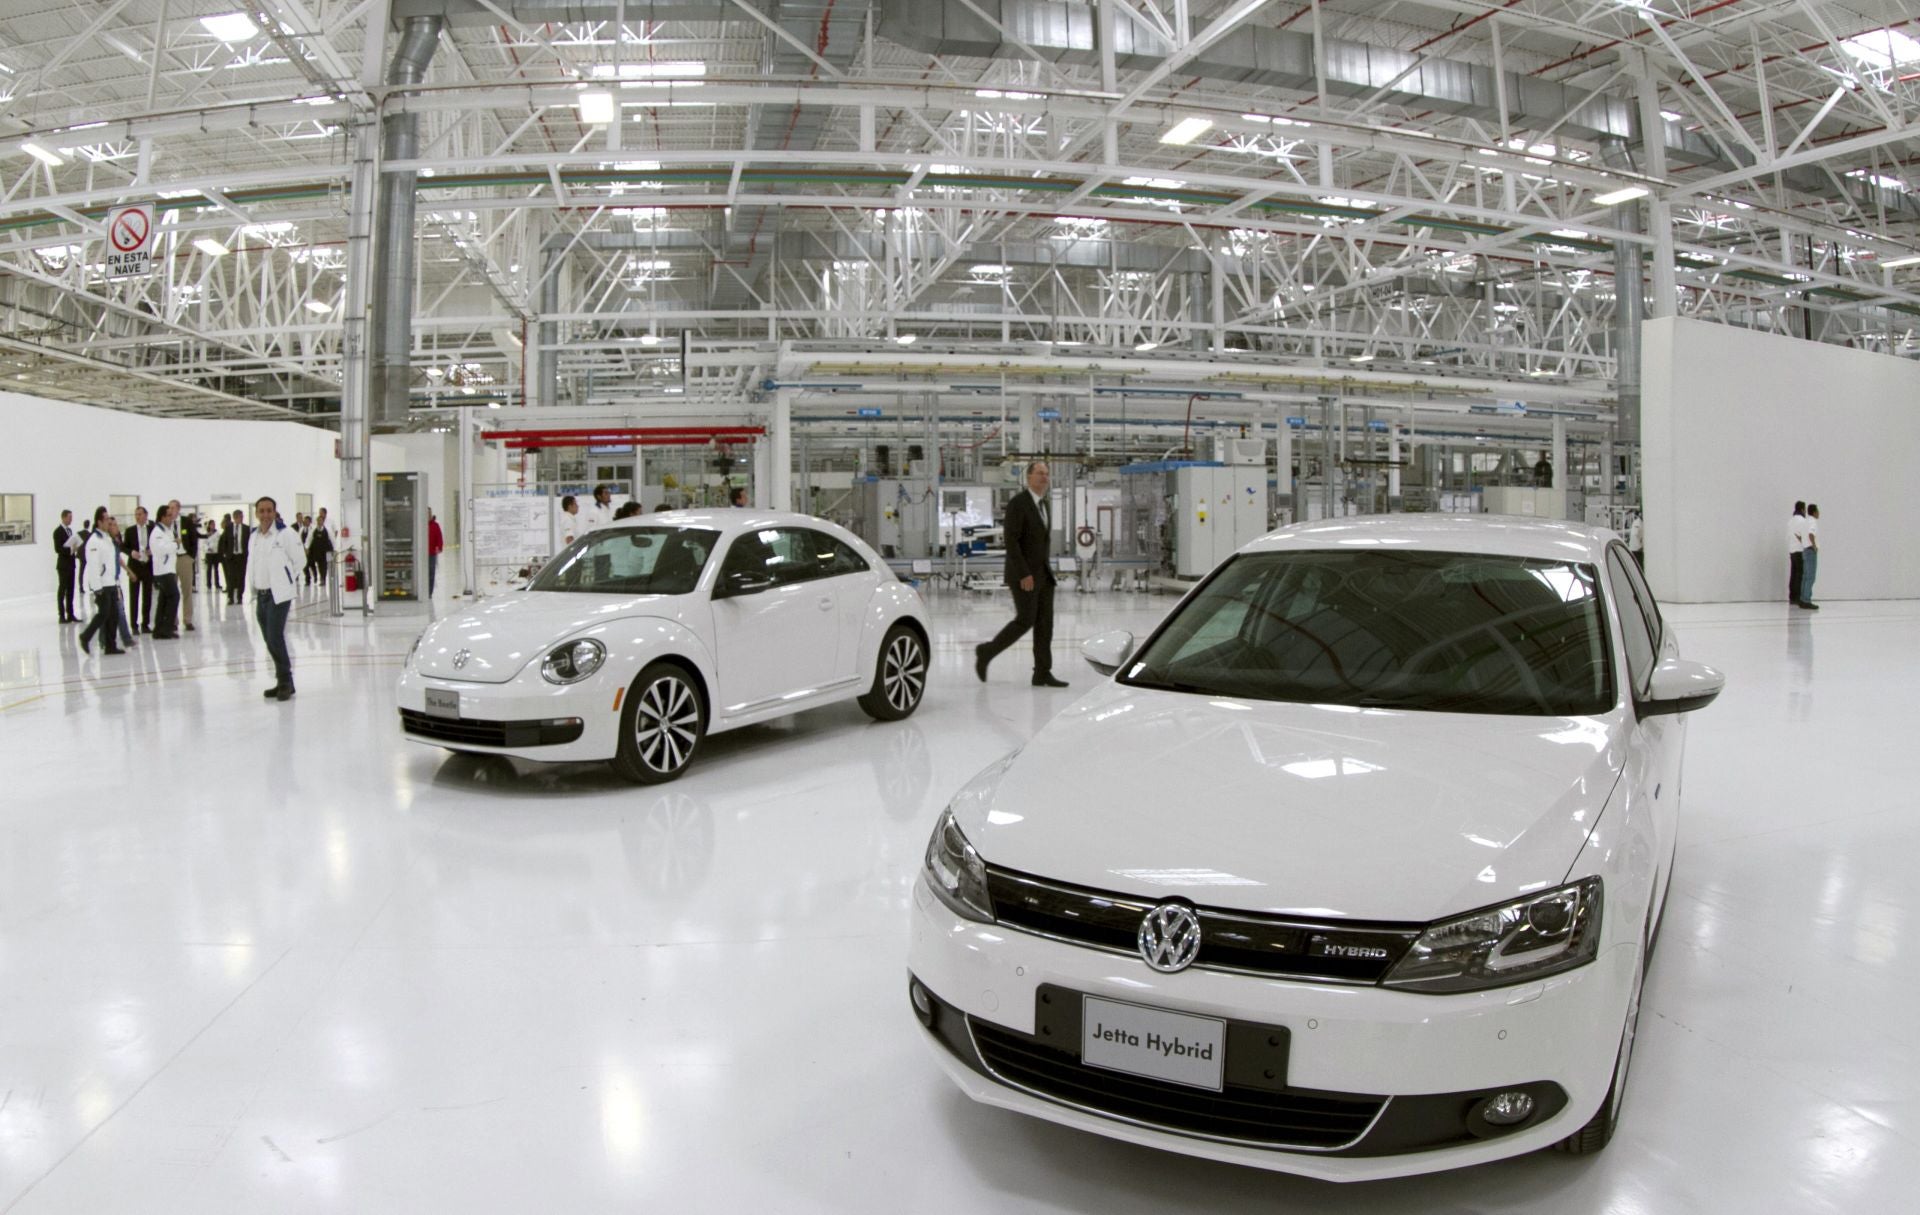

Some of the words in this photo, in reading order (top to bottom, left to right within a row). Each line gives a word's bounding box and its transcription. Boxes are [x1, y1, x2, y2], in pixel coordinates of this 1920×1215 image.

[108, 255, 120, 265] EN
[124, 252, 149, 263] ESTA
[114, 263, 141, 275] NAVE
[1324, 944, 1387, 957] HYBRID
[1092, 1022, 1140, 1047] Jetta
[1146, 1032, 1213, 1061] Hybrid
